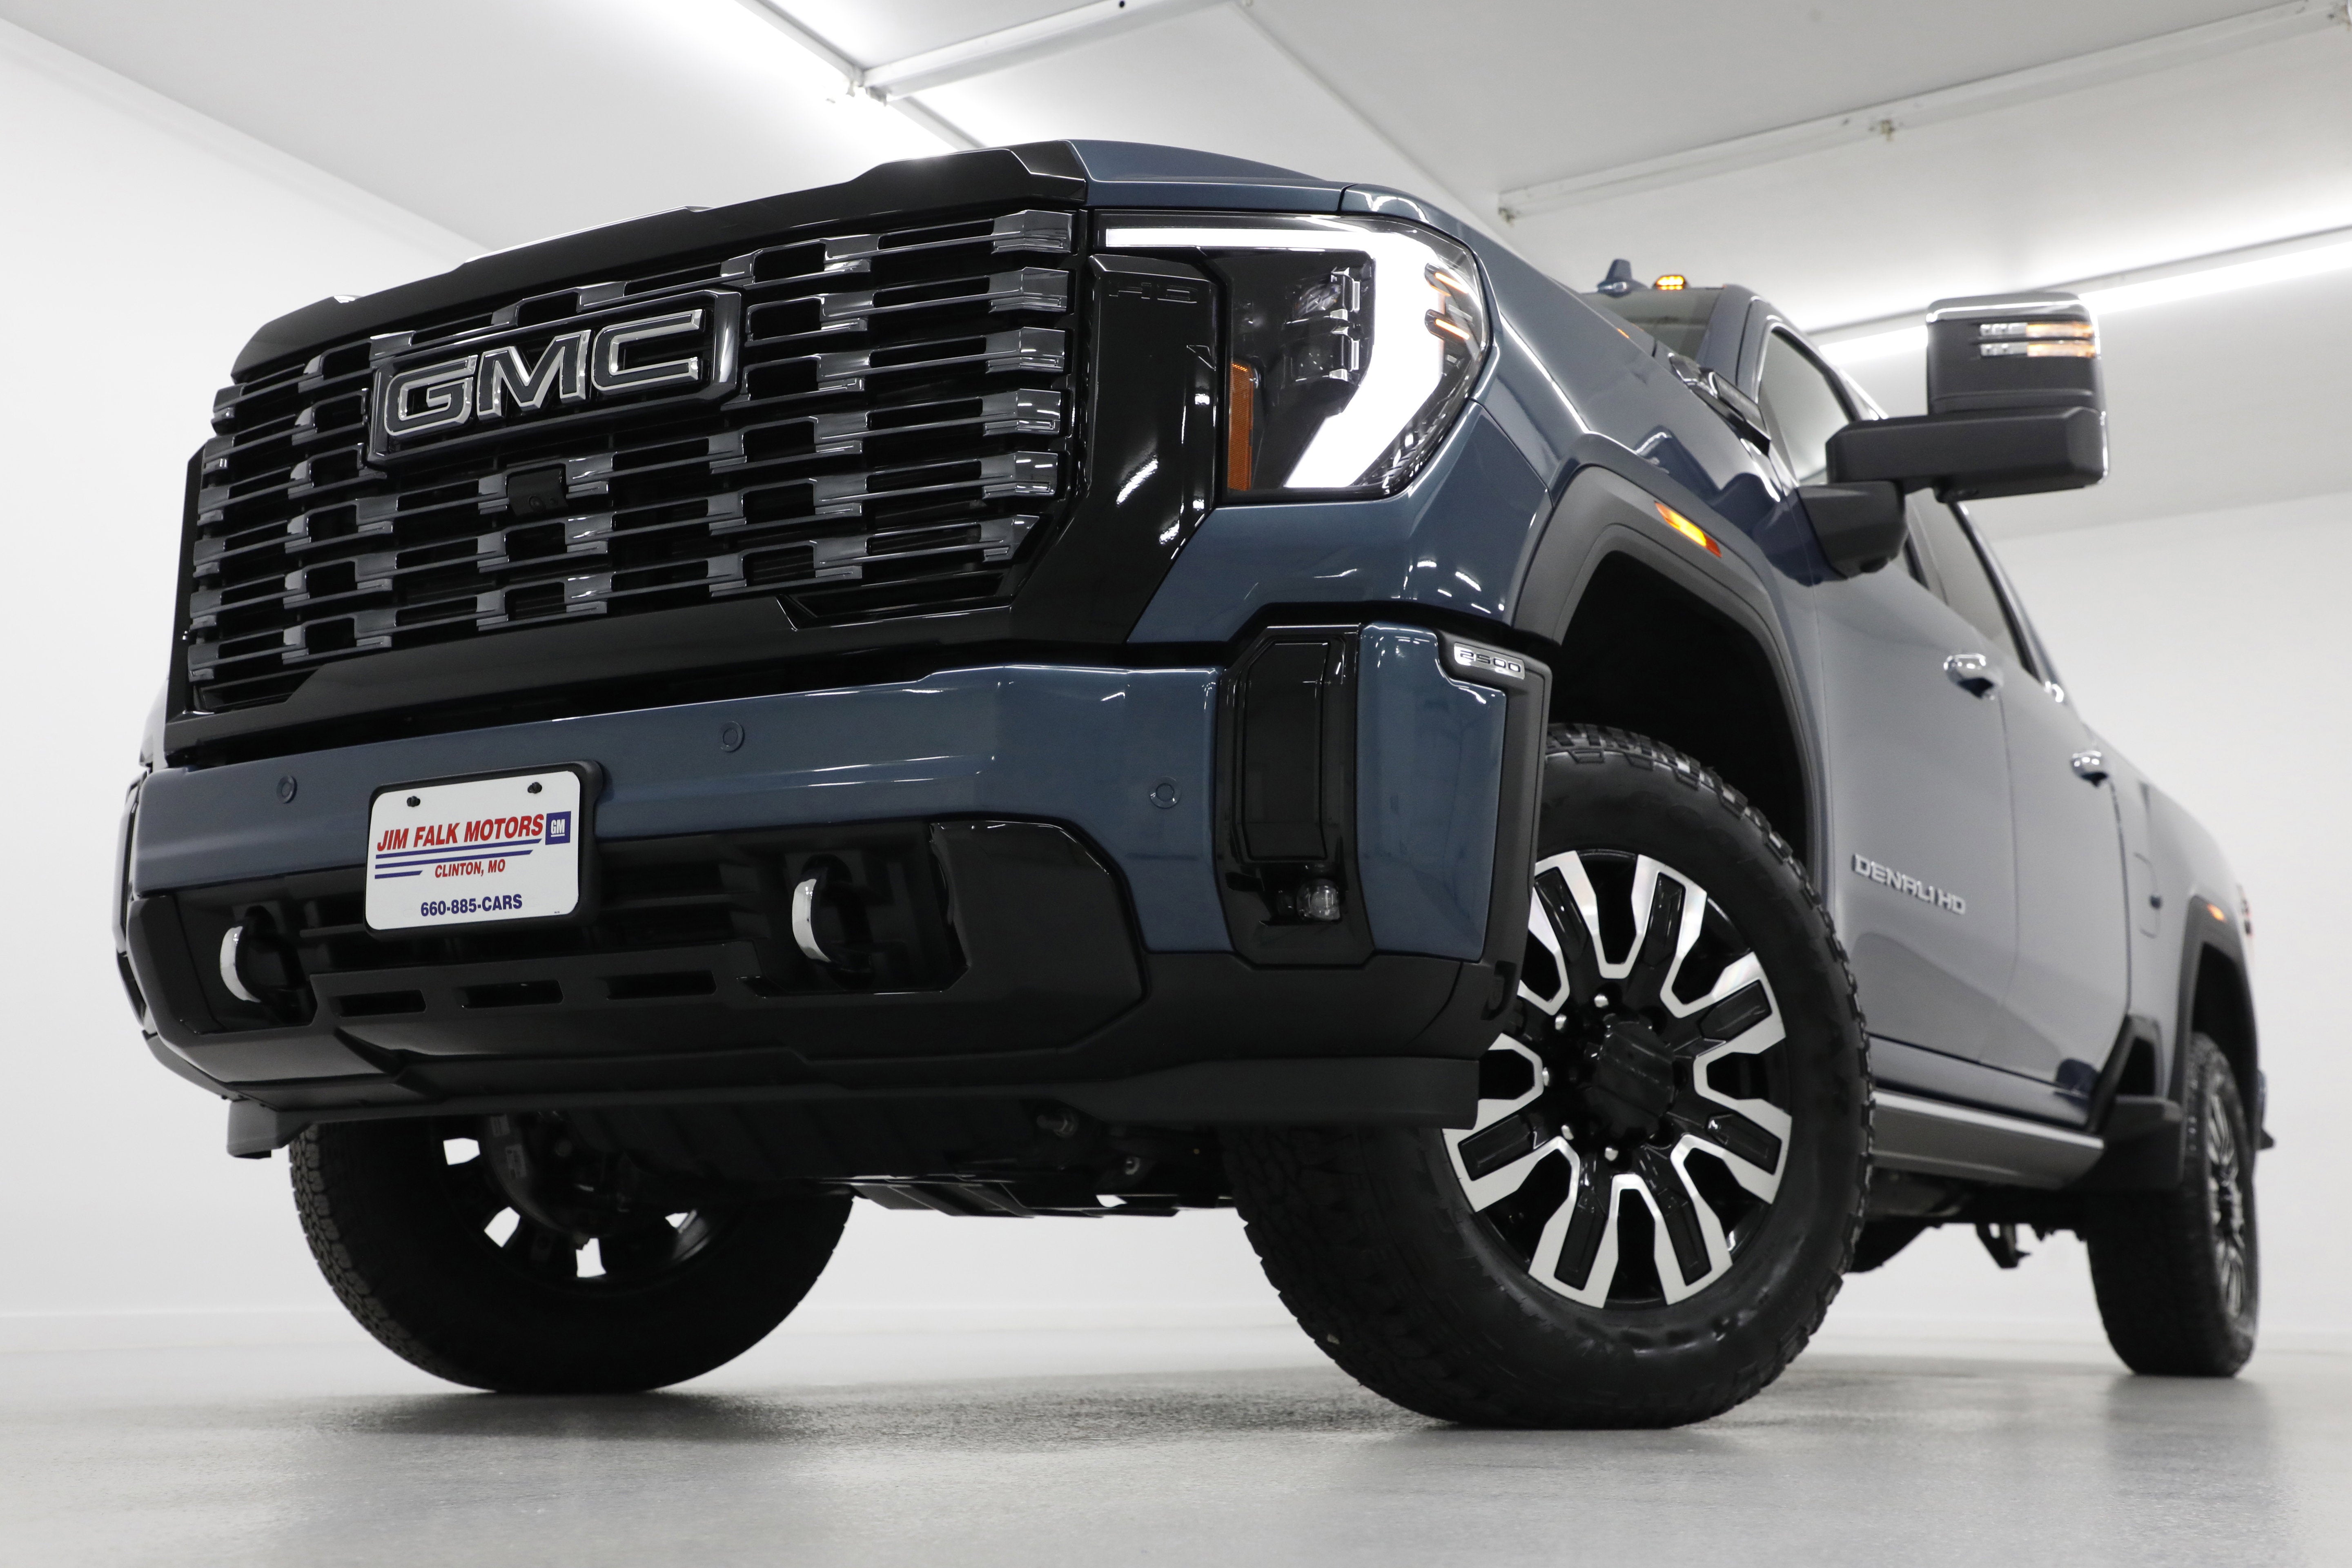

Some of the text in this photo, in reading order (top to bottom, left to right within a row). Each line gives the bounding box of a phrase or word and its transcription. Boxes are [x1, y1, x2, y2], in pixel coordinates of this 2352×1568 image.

[384, 308, 704, 437] GMC
[1459, 649, 1521, 673] 2500
[377, 814, 544, 851] JIM FALK MOTORS
[550, 819, 565, 834] GM
[435, 859, 506, 878] CLINTON, MO
[1851, 853, 1966, 915] DENALI HD
[421, 894, 522, 917] 660-885-CARS
